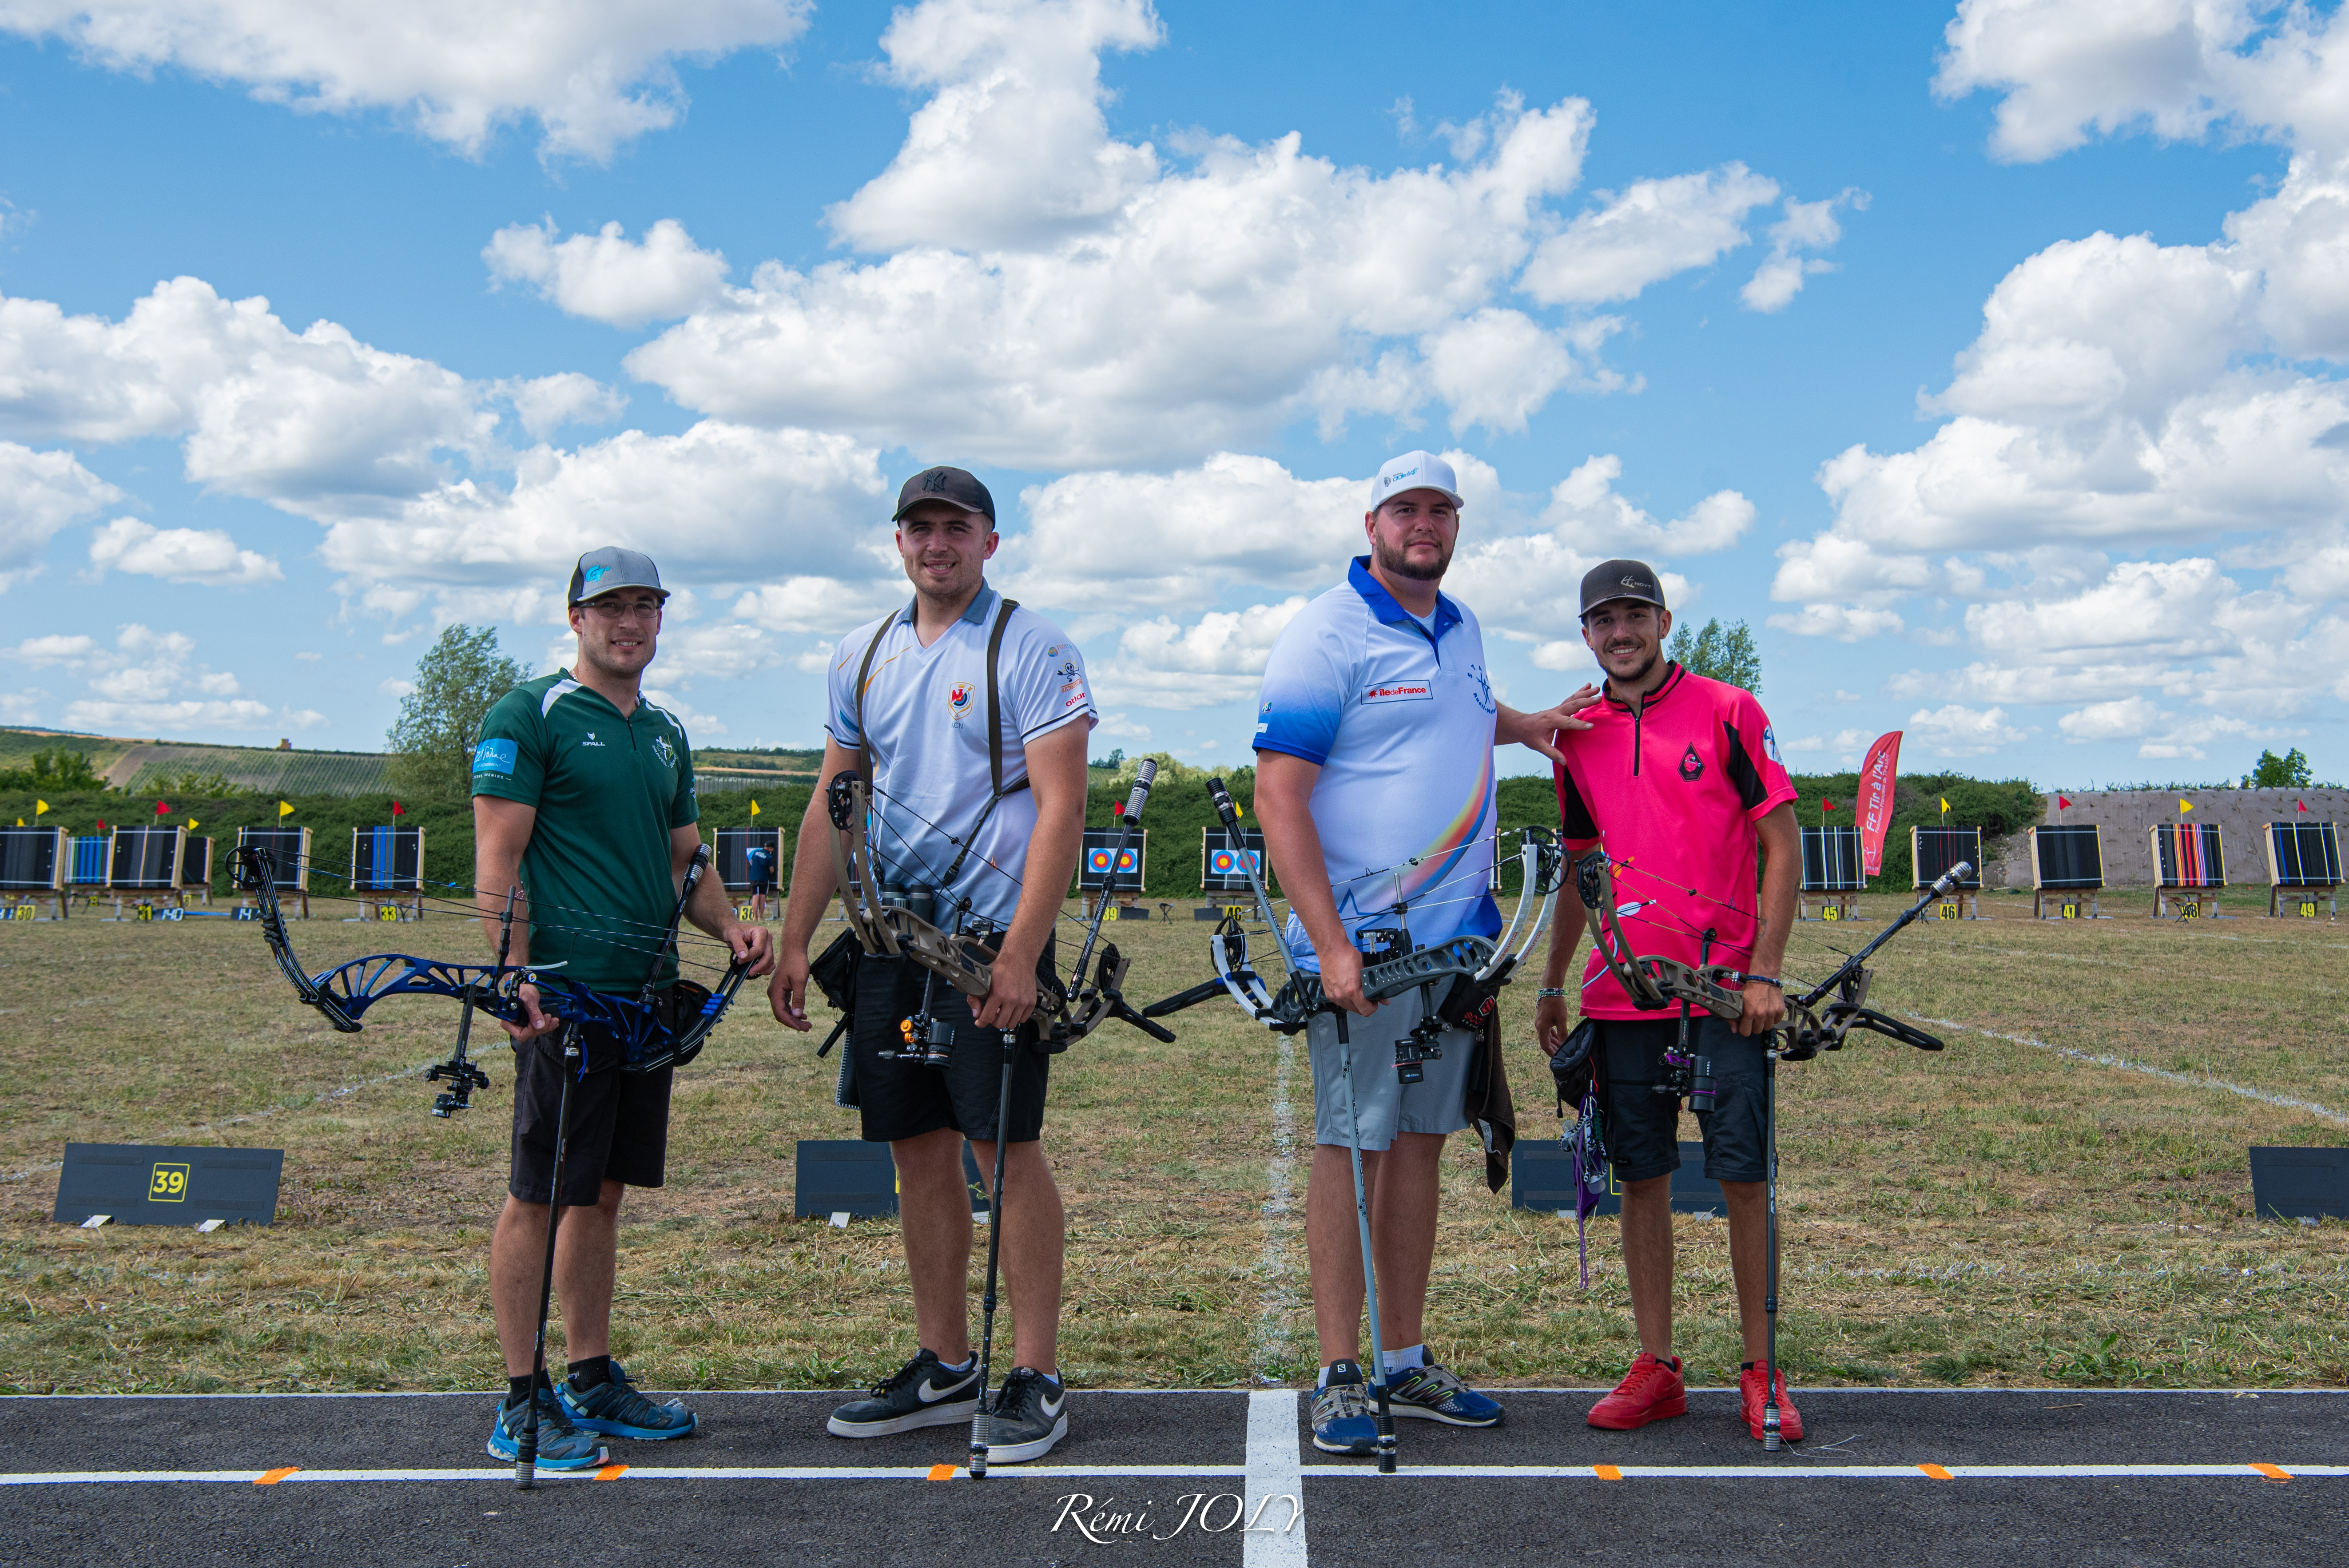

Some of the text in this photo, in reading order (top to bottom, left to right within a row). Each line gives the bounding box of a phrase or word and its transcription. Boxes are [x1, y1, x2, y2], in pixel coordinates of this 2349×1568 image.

[1872, 750, 1885, 780] l'Arc
[1869, 792, 1880, 810] Tir
[1866, 812, 1877, 832] FF
[20, 907, 32, 920] 30
[161, 908, 184, 921] 140
[382, 906, 396, 921] 33
[1103, 907, 1117, 921] 39
[1227, 907, 1242, 921] 40
[1823, 907, 1837, 921] 45
[1941, 905, 1955, 919] 46
[2063, 905, 2075, 918] 47
[2301, 902, 2314, 917] 49
[1498, 931, 1518, 961] DOMINATOR
[1521, 930, 1542, 961] DOMINATOR
[152, 1171, 184, 1194] 39
